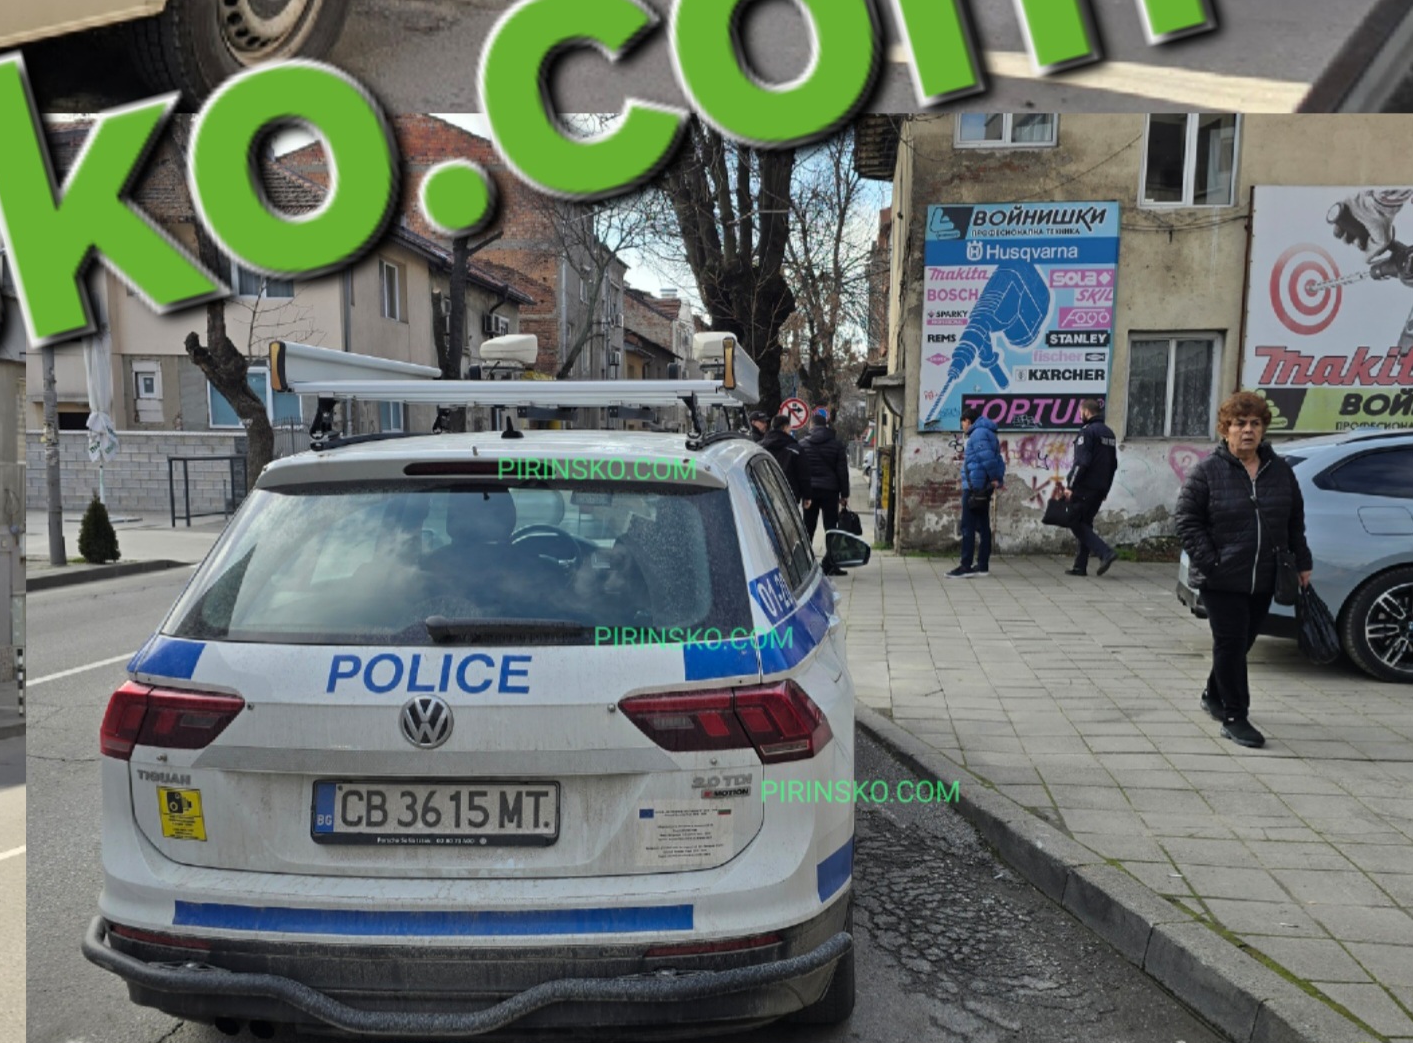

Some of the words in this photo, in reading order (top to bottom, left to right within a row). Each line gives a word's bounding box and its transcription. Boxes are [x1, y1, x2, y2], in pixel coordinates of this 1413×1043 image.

[973, 205, 1107, 232] ВОЙНИШКИ
[1046, 228, 1081, 236] ТЕХНИКА
[986, 244, 1078, 262] Husqvarna
[927, 288, 980, 302] BOSCH
[1076, 288, 1114, 305] SKIL
[935, 310, 968, 318] SPARKY
[927, 333, 956, 343] REMS
[1049, 333, 1108, 344] STANLEY
[1033, 350, 1083, 363] fischer
[1028, 369, 1105, 381] KÄRCHER
[326, 653, 533, 694] POLICE
[137, 769, 192, 785] TIGUAN
[723, 773, 752, 786] TDI
[340, 789, 387, 827] CB
[397, 789, 490, 828] 3615
[498, 790, 549, 829] MT
[316, 814, 333, 826] BG
